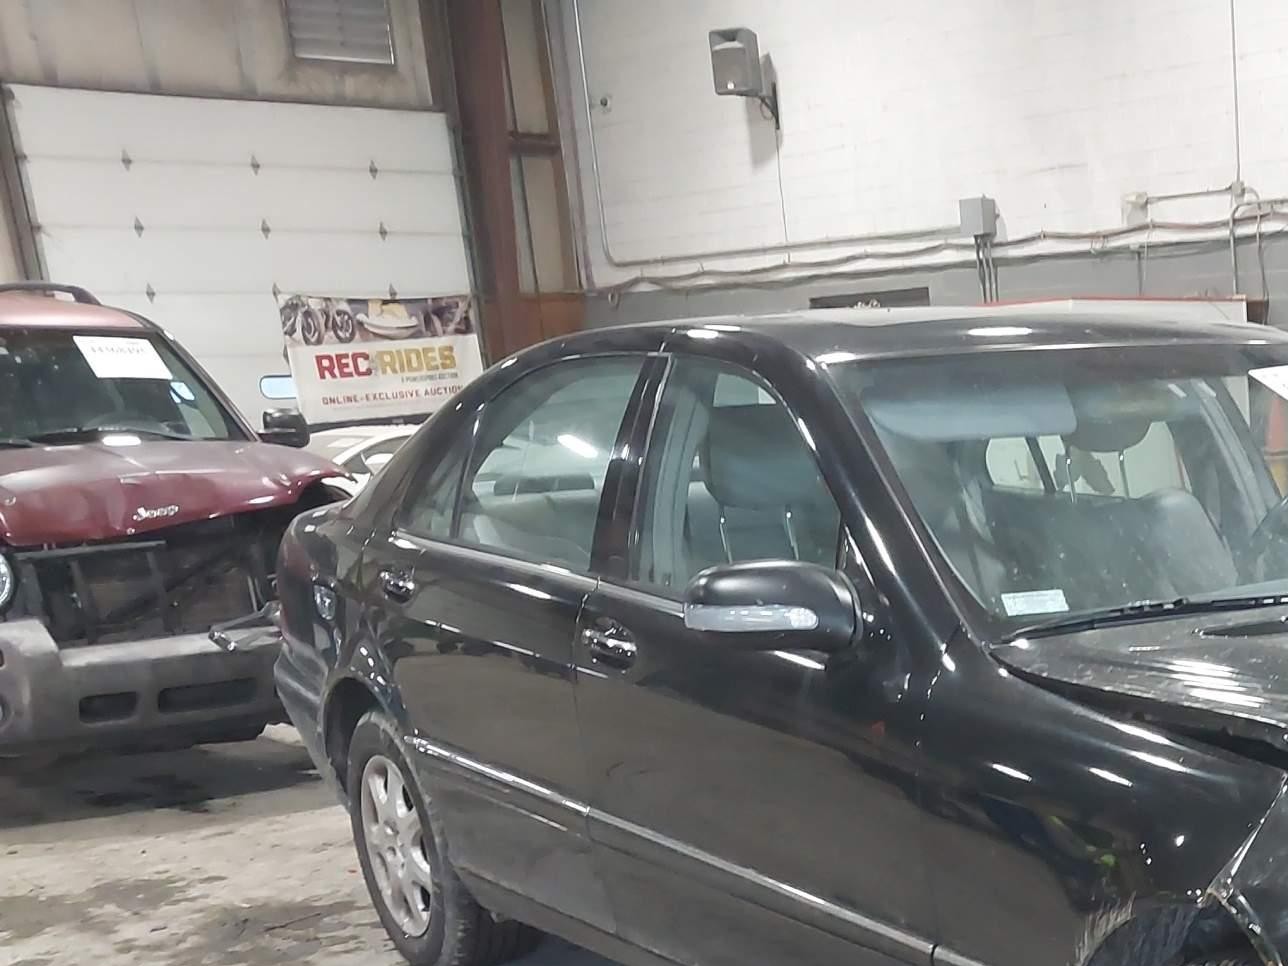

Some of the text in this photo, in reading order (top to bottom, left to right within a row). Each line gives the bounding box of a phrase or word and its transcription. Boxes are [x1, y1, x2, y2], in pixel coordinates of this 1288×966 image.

[315, 352, 372, 379] REC
[376, 345, 456, 374] RIDES
[322, 389, 419, 405] ONLINE-EXCLUSIVE
